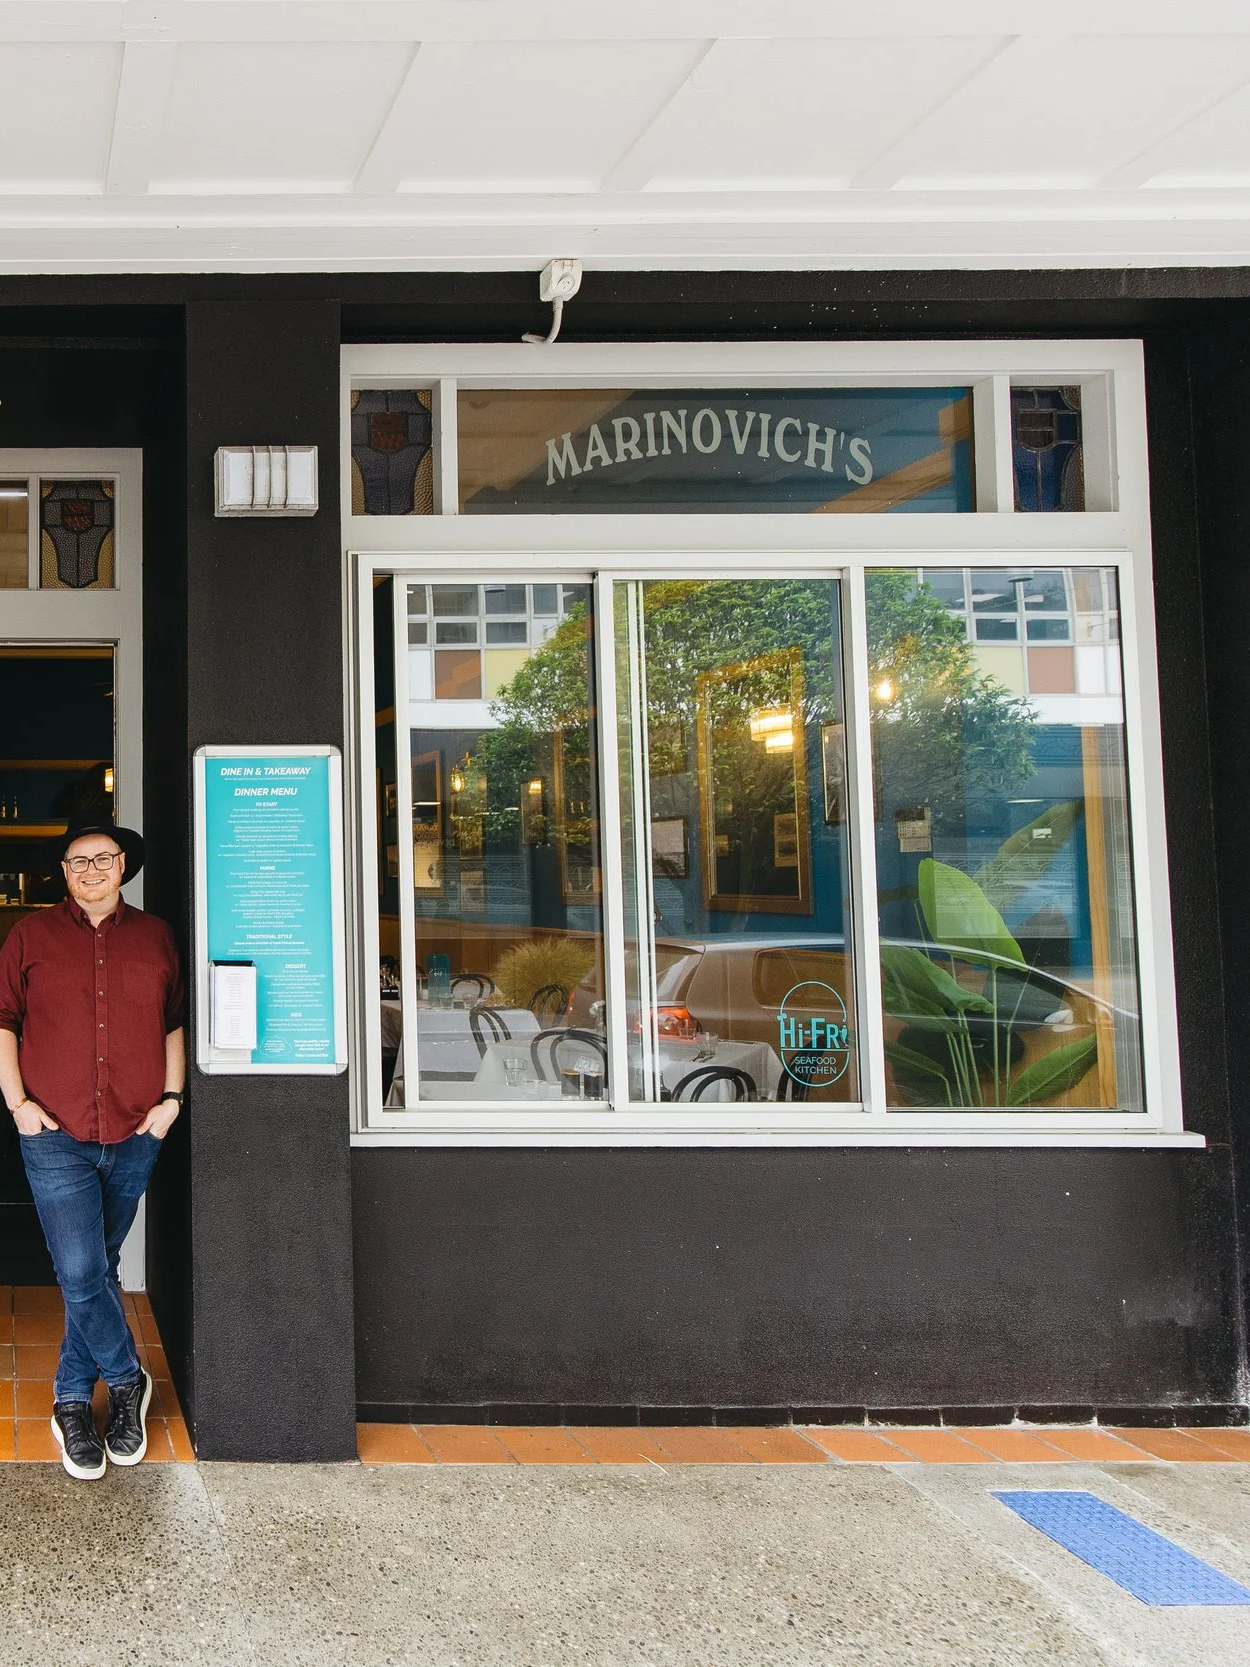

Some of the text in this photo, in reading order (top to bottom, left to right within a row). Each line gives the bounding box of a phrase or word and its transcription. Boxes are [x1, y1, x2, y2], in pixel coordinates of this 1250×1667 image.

[545, 408, 874, 486] MARINOVICH'S
[220, 768, 242, 776] DINE
[263, 767, 311, 775] TAKEAWAY
[234, 787, 298, 796] DINNER MENU
[794, 1056, 837, 1065] SEAFOOD
[794, 1066, 837, 1075] KITCHEN
